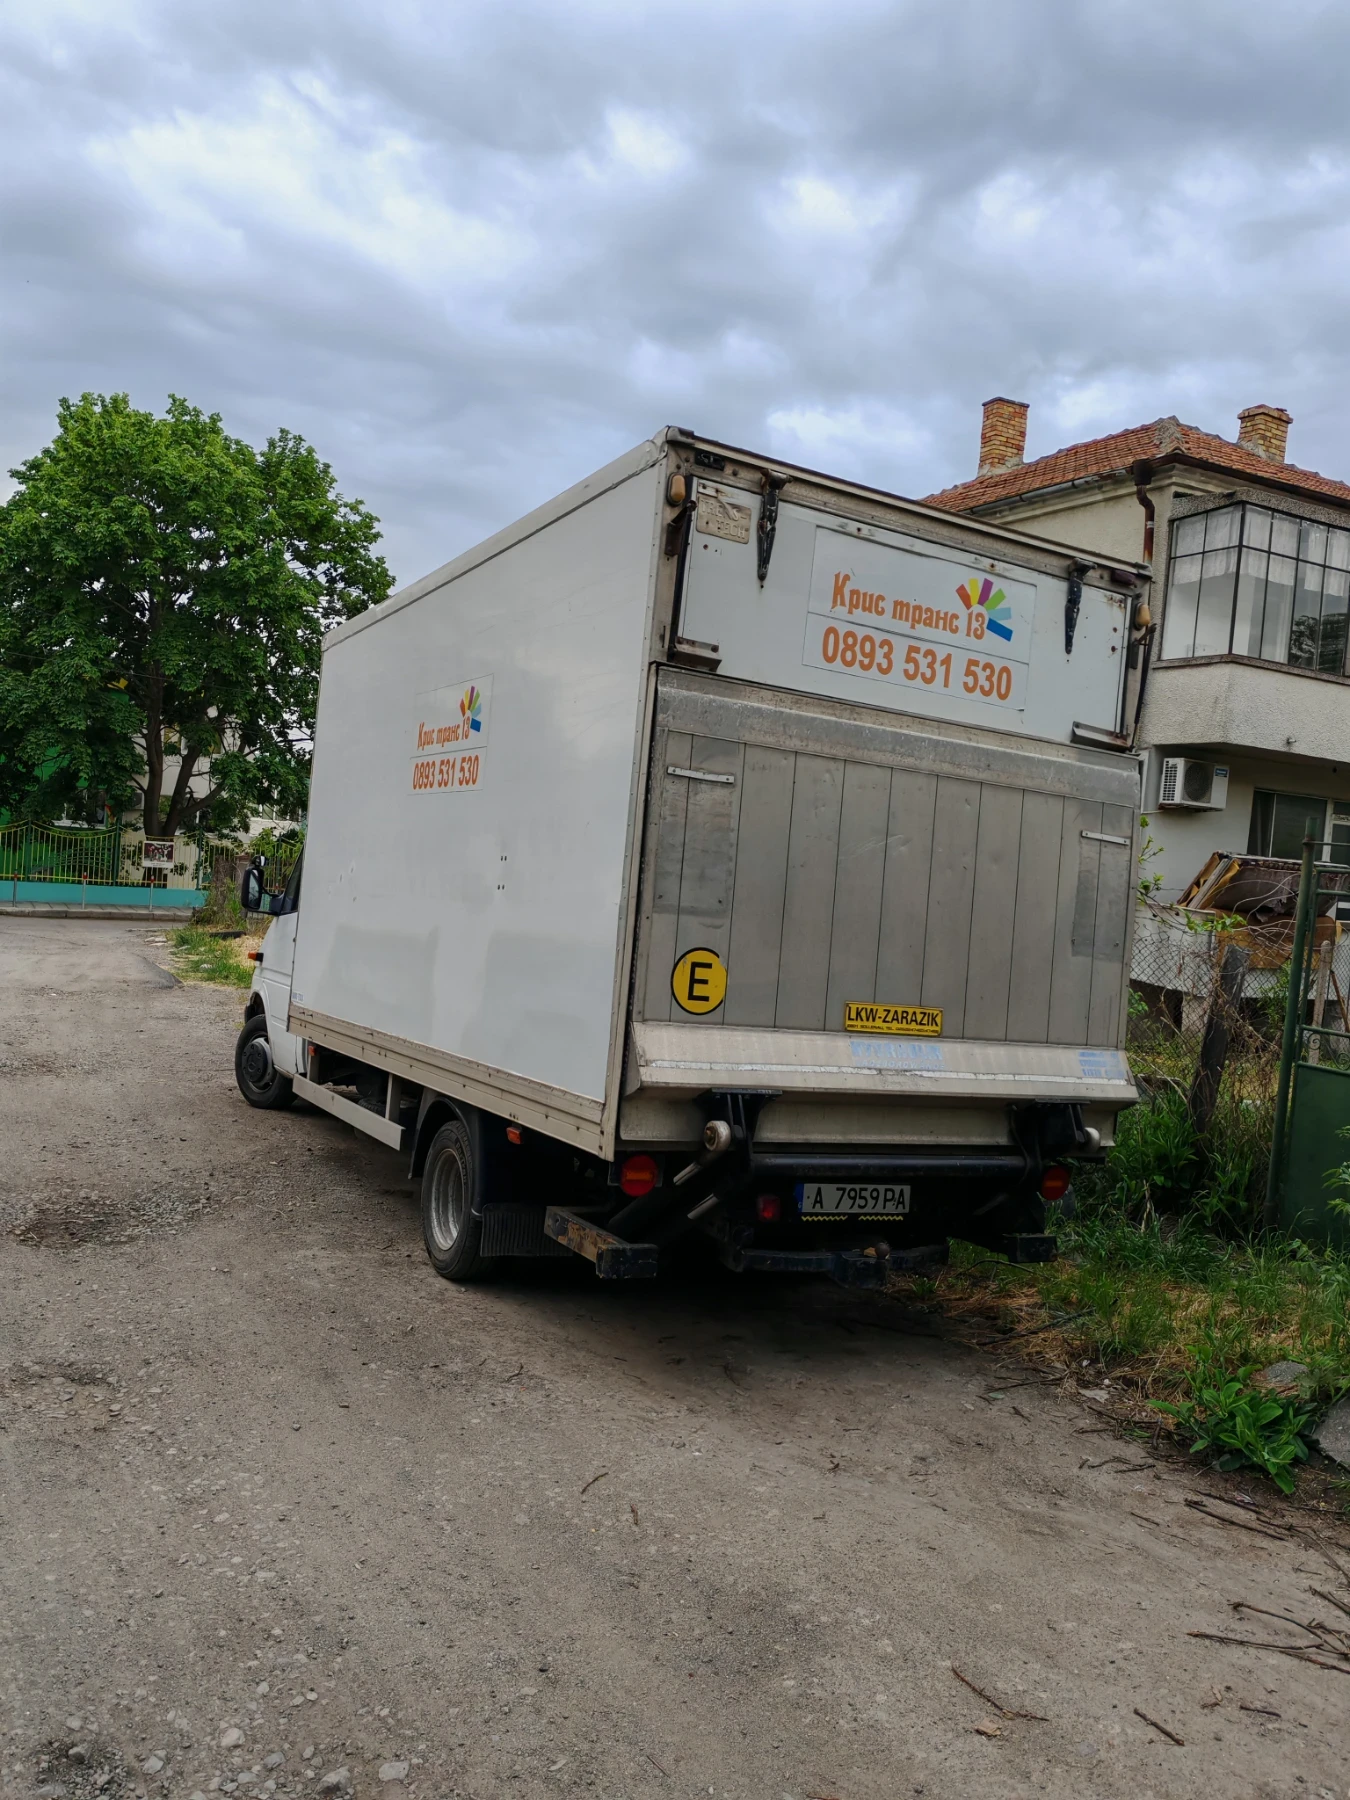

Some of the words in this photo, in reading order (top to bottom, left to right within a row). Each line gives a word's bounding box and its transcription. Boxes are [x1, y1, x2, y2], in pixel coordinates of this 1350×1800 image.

[831, 571, 886, 616] Крис
[891, 598, 960, 634] транс
[965, 610, 987, 640] 13
[822, 626, 894, 675] 0893
[903, 644, 952, 688] 531
[963, 658, 1012, 701] 530
[461, 715, 471, 740] 13
[412, 760, 436, 790] 0893
[437, 757, 457, 788] 531
[458, 754, 479, 787] 530
[687, 961, 713, 1003] E
[847, 1006, 940, 1027] LKW-ZARAZIK
